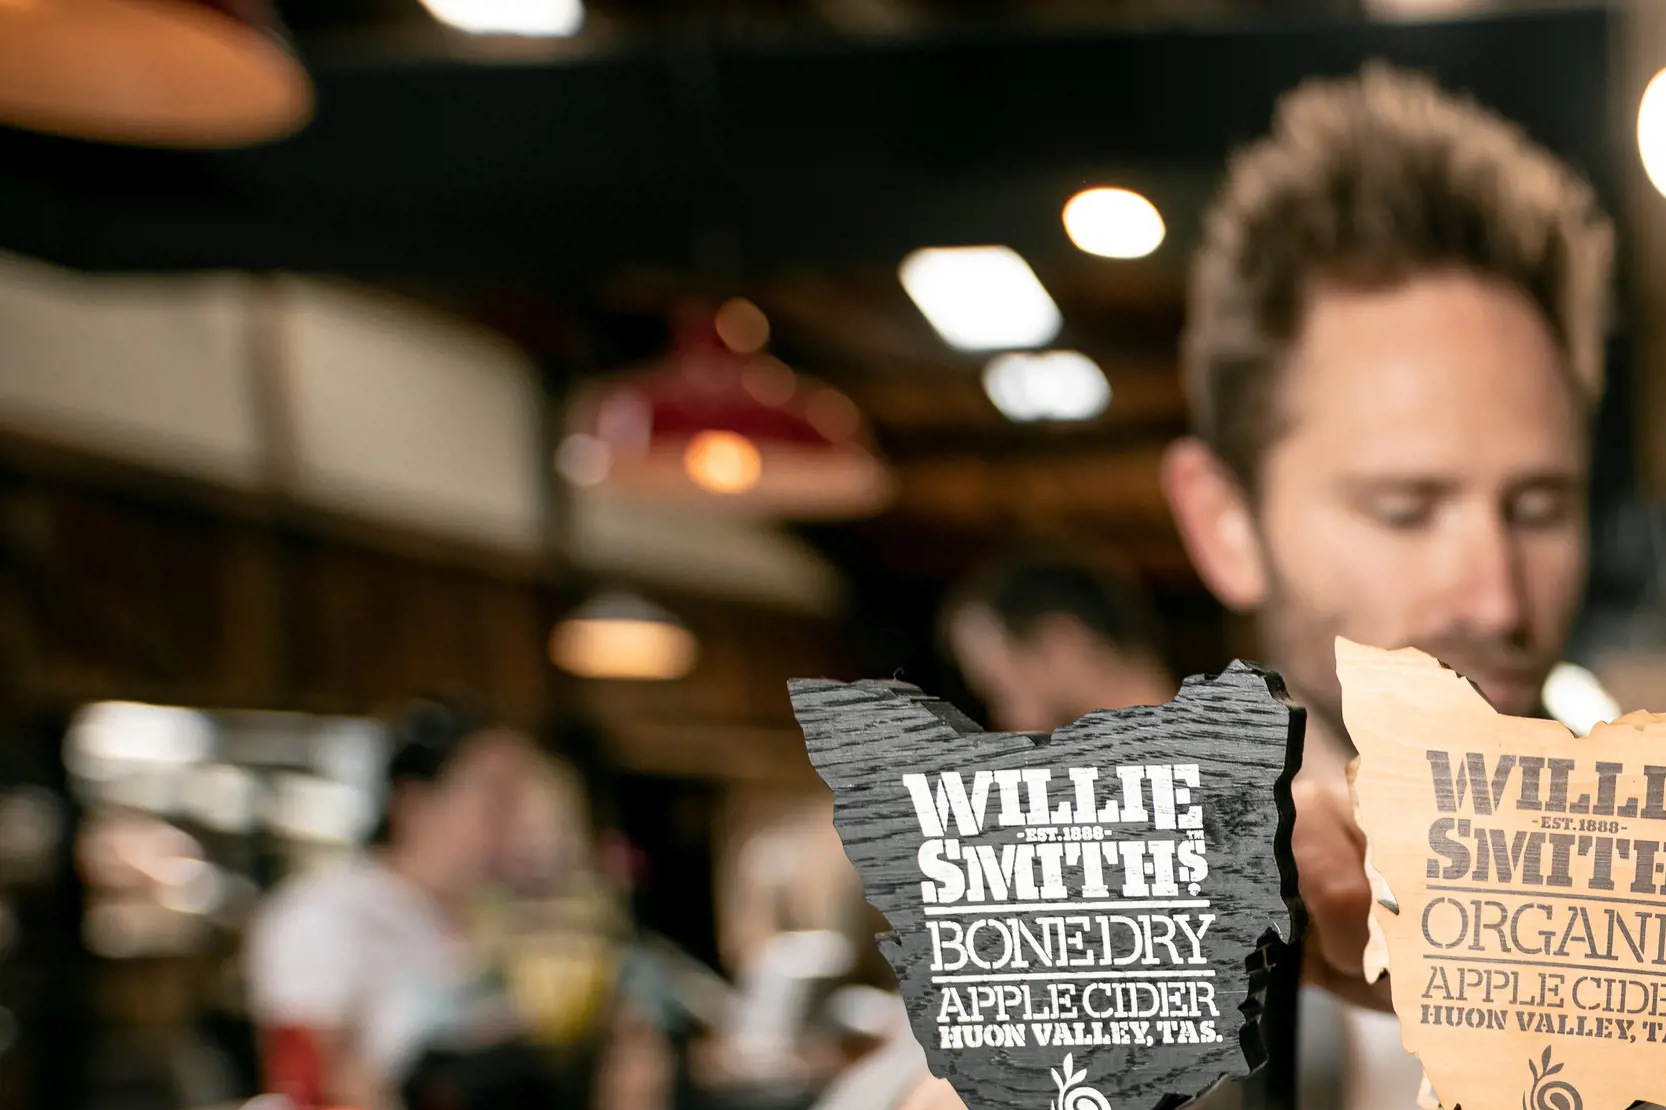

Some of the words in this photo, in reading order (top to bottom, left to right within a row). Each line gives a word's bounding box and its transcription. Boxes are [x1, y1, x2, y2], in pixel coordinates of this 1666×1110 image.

[902, 763, 1203, 837] WILLIE
[936, 983, 1078, 1023] APPLE
[1082, 981, 1220, 1018] CIDER
[1421, 965, 1565, 1008] APPLE
[938, 1023, 1026, 1049] HUON
[1031, 1021, 1154, 1047] VALLEY,
[1156, 1020, 1224, 1044] TAS.
[1420, 1004, 1508, 1030] HUON
[1514, 1011, 1636, 1043] VALLEY,
